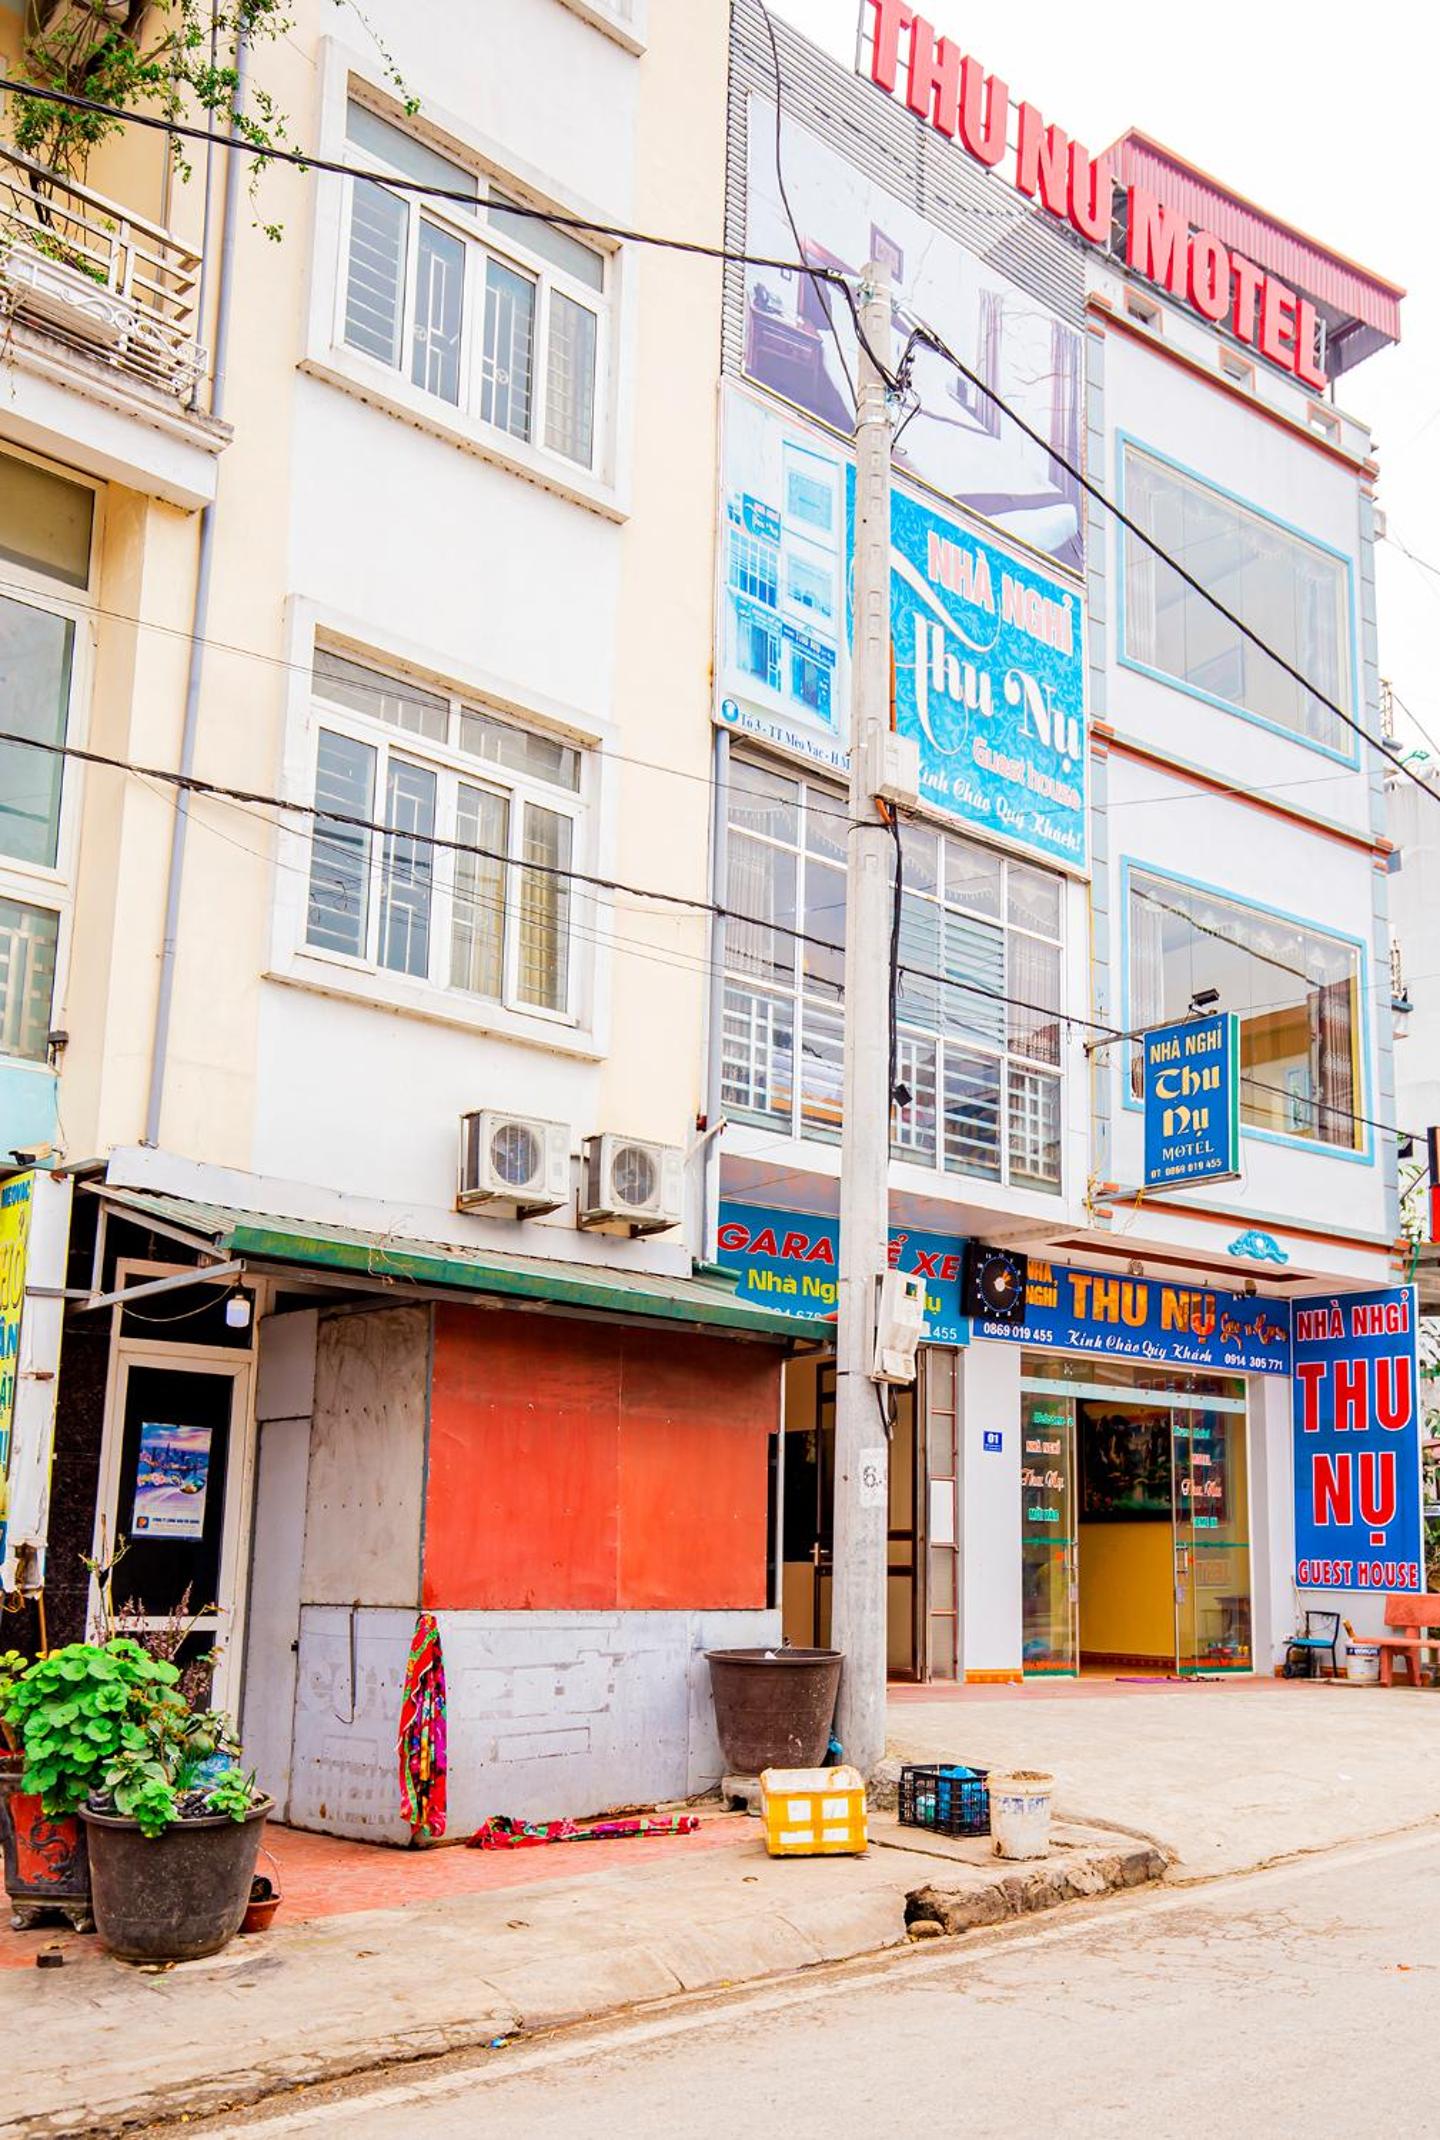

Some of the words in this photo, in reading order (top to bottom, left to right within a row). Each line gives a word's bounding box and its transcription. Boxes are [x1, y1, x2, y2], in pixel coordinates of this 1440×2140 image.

[866, 0, 1009, 168] THU
[1125, 186, 1328, 392] MOTEL
[927, 529, 996, 616] NHÀ
[1001, 573, 1074, 658] NGHỈ
[1003, 667, 1082, 774] Nụ
[1150, 1035, 1181, 1064] NHÀ
[1185, 1021, 1223, 1056] NGHỈ
[1154, 1065, 1221, 1100] Thu
[1163, 1105, 1209, 1137] Nụ
[1162, 1139, 1214, 1161] MOTEL
[718, 1223, 835, 1265] GARA
[910, 1250, 962, 1281] XE
[748, 1269, 798, 1295] Nhà
[1068, 1273, 1149, 1327] THU
[1160, 1288, 1216, 1344] NỤ
[1296, 1299, 1345, 1342] NHÀ
[983, 1322, 1010, 1337] 0869
[1012, 1326, 1031, 1340] 019
[1032, 1329, 1053, 1343] 455
[1105, 1335, 1140, 1353] Chào
[1170, 1344, 1213, 1363] Khách
[1224, 1352, 1247, 1367] 0914
[1249, 1356, 1267, 1369] 305
[1268, 1358, 1283, 1371] 771
[1296, 1355, 1412, 1433] THU
[987, 1433, 999, 1444] 01
[1312, 1452, 1397, 1547] NỤ
[1298, 1560, 1353, 1585] GUEST
[1357, 1561, 1419, 1589] HOUSE
